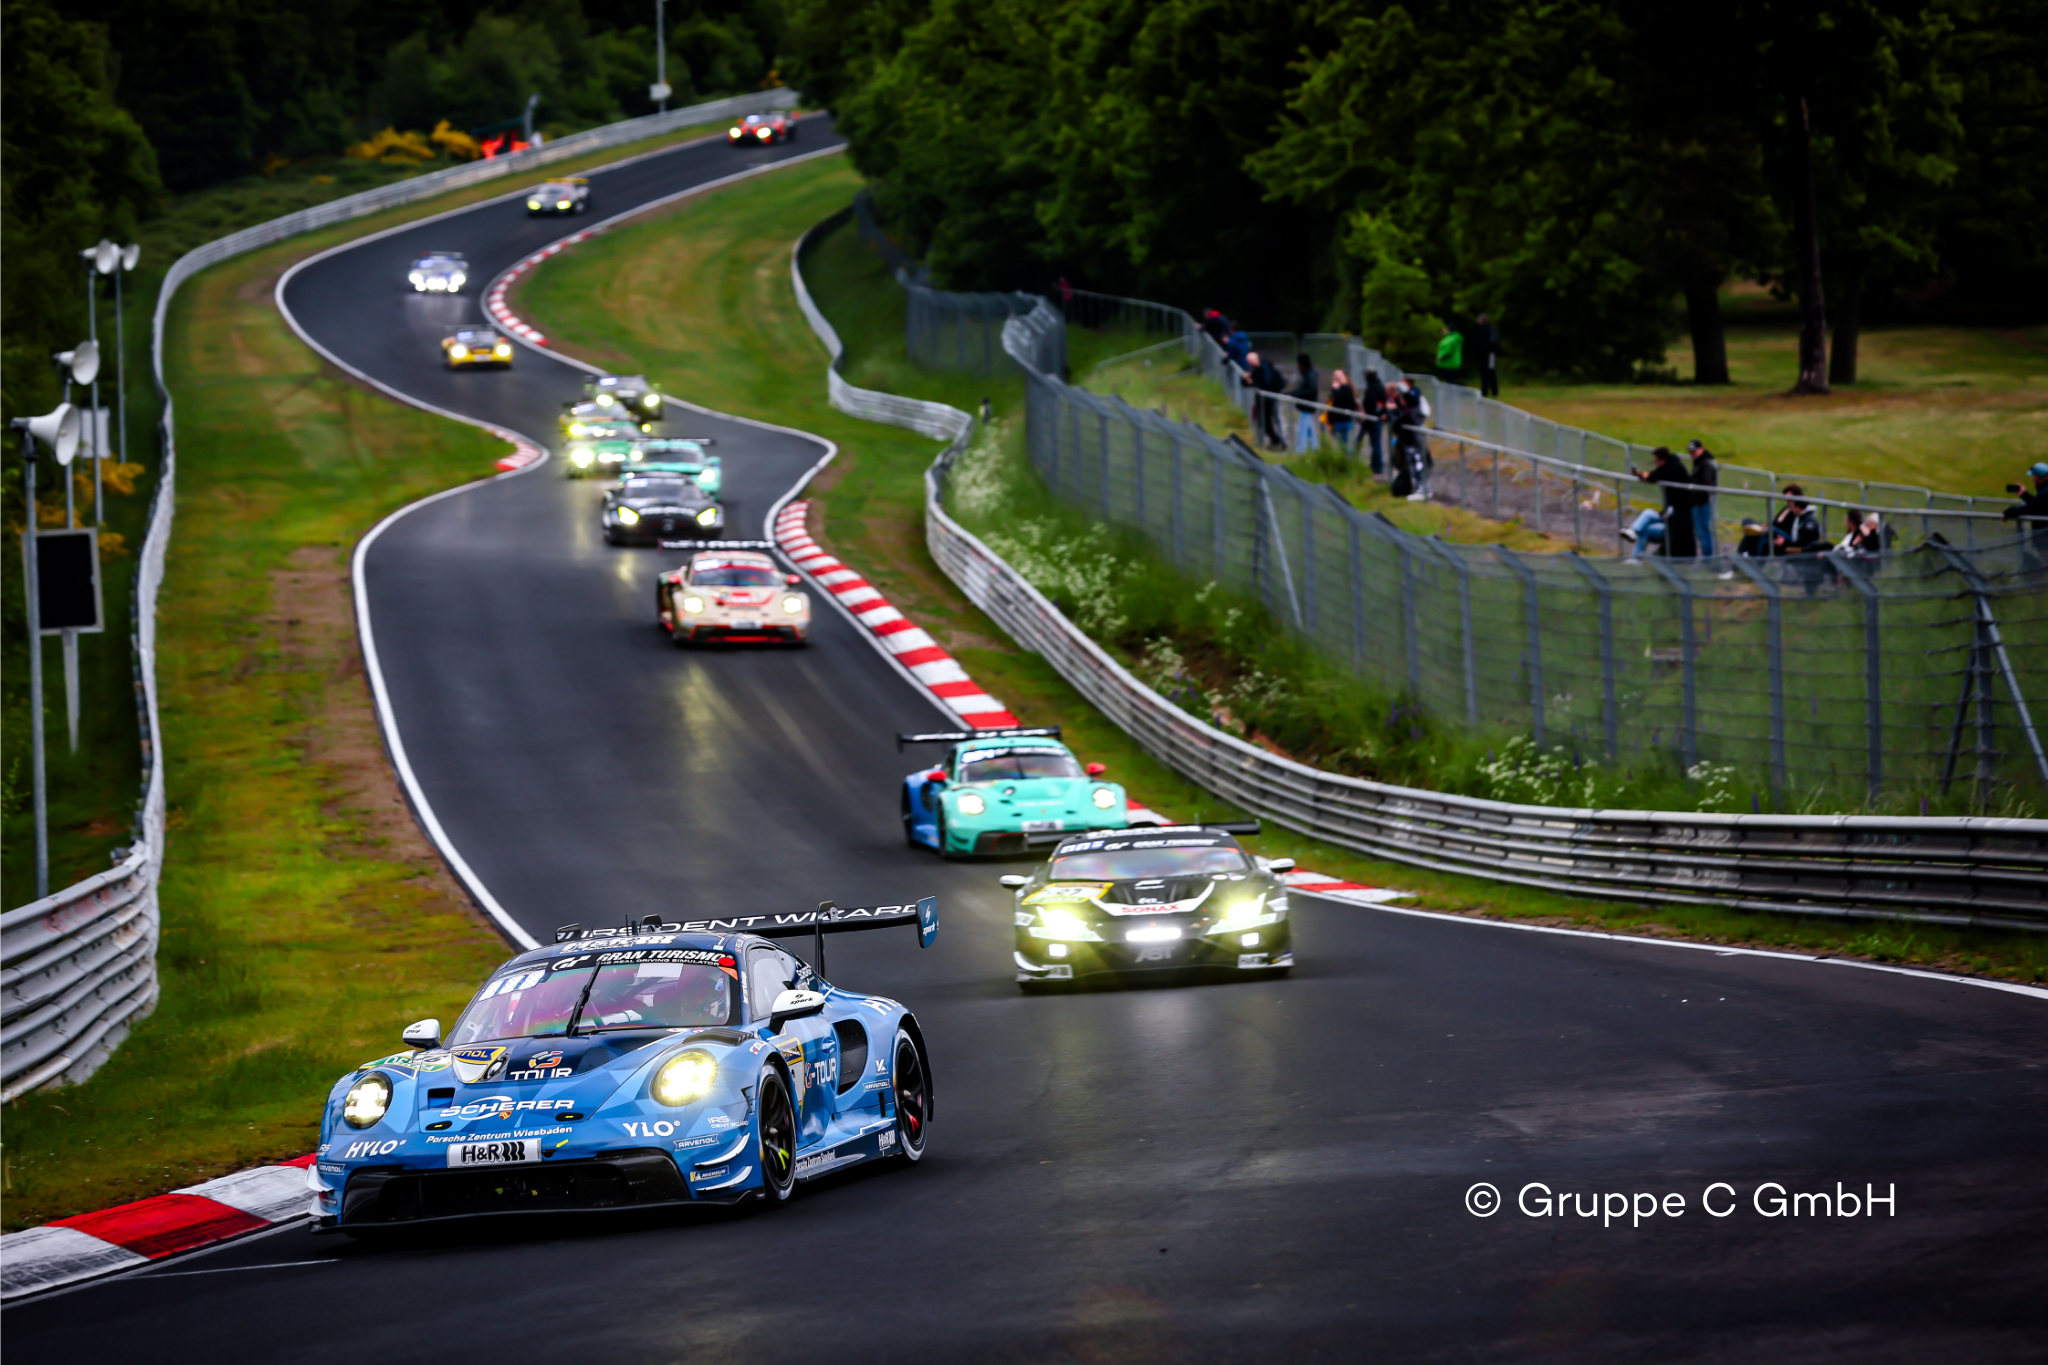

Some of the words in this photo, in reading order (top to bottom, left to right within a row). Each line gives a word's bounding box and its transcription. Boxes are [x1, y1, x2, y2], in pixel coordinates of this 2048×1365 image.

[1122, 904, 1179, 913] SONAX
[659, 916, 766, 933] DENT
[599, 950, 646, 962] GRAN
[1134, 947, 1173, 963] ABT
[671, 958, 720, 966] SIMULATOR
[790, 997, 814, 1005] spark
[440, 1100, 575, 1117] SCHERER
[426, 1135, 466, 1143] Porsche
[468, 1133, 511, 1141] Zentrum
[513, 1126, 573, 1138] Wiesbaden
[678, 1137, 716, 1148] RAVENOL
